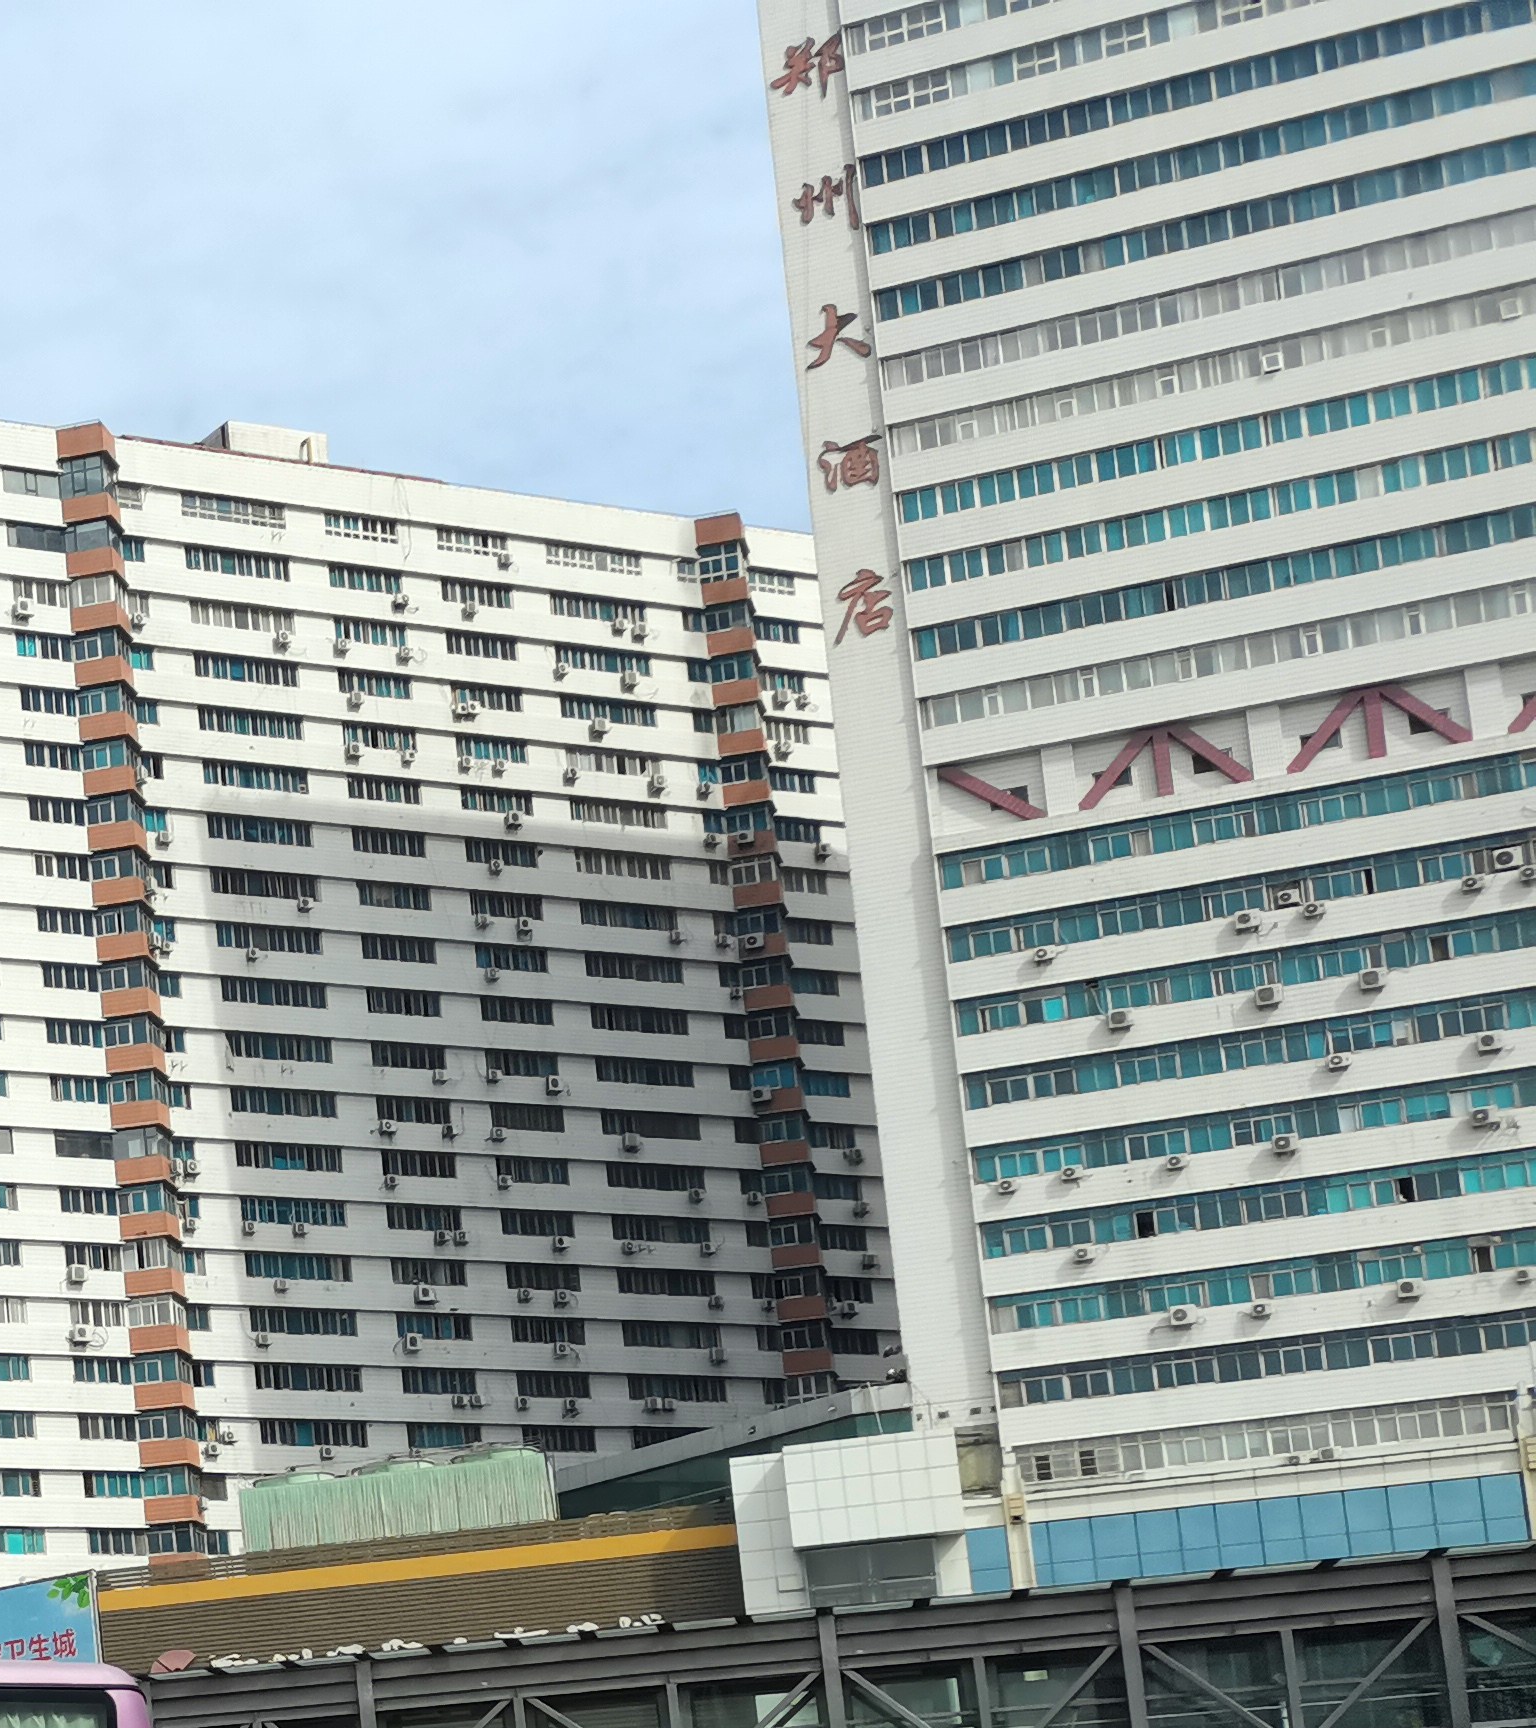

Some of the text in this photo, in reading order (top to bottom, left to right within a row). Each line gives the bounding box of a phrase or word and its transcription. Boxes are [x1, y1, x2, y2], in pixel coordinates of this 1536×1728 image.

[769, 26, 894, 646] 郑州大酒店
